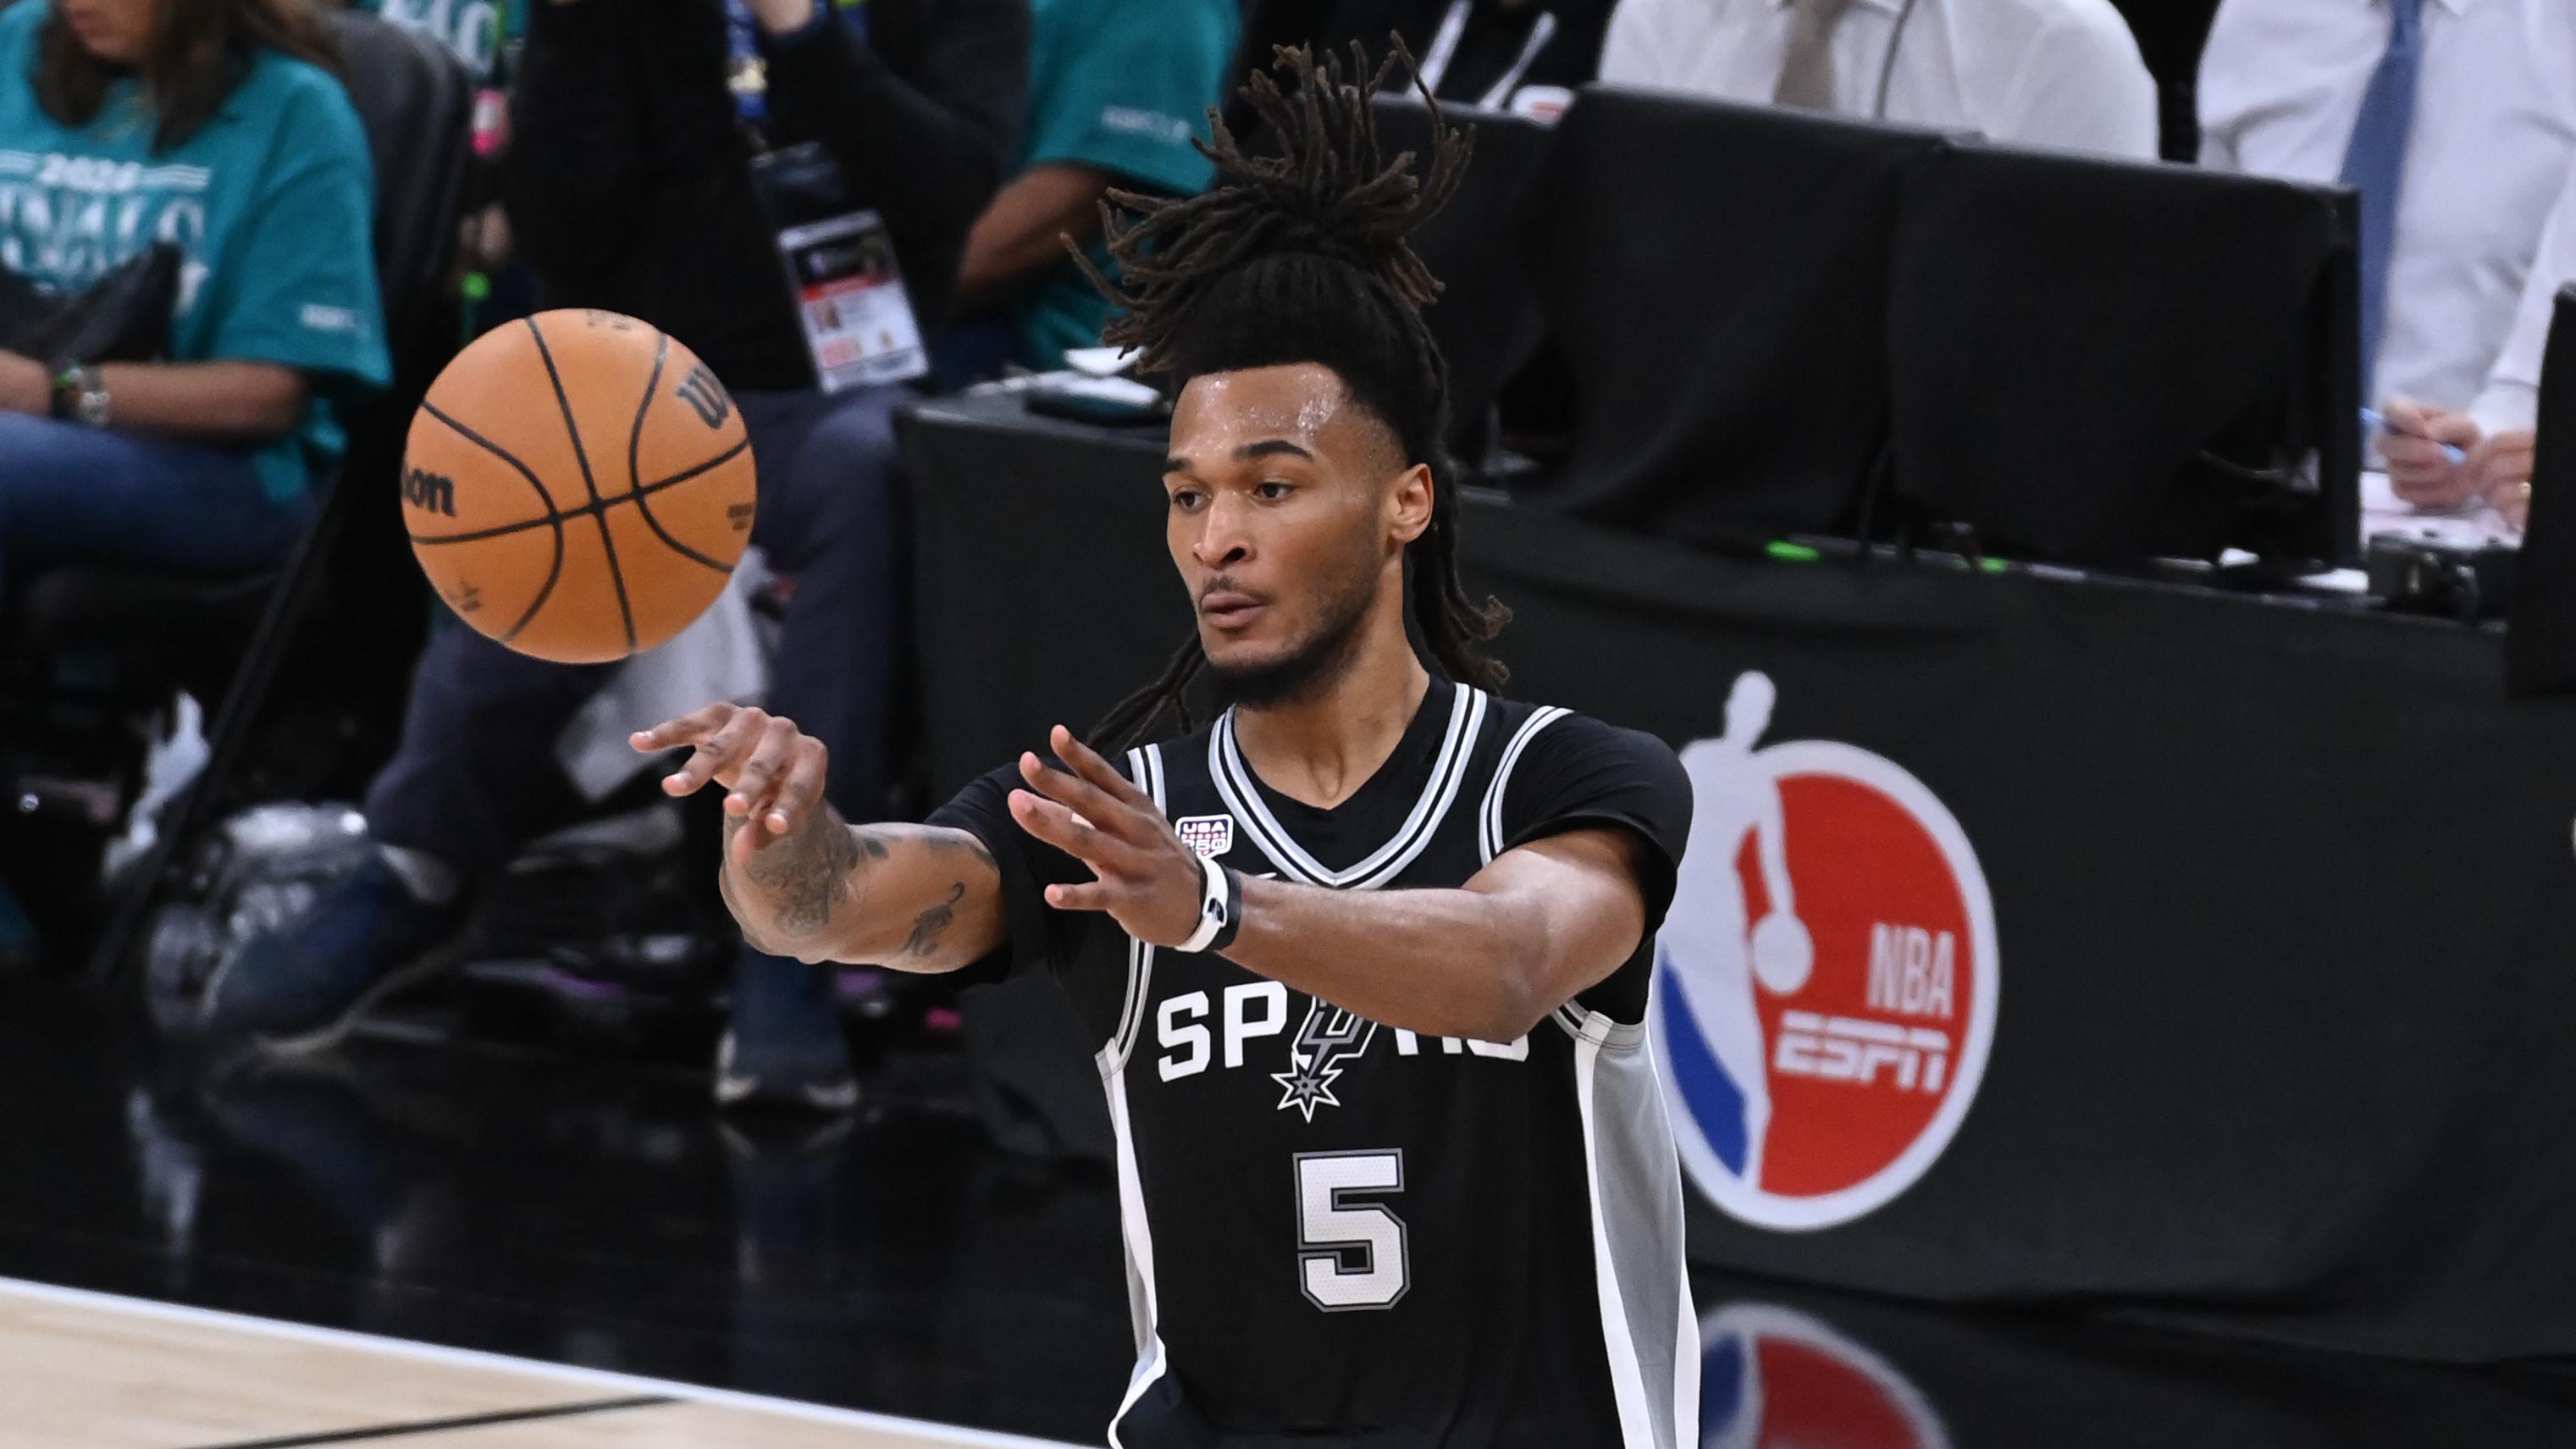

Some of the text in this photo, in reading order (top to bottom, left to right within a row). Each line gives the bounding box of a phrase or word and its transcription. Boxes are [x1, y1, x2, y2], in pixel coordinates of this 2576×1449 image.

[1183, 821, 1226, 834] USA
[1866, 921, 1955, 1019] NBA
[1774, 1008, 1949, 1092] ESPN
[1292, 1148, 1411, 1313] 5
